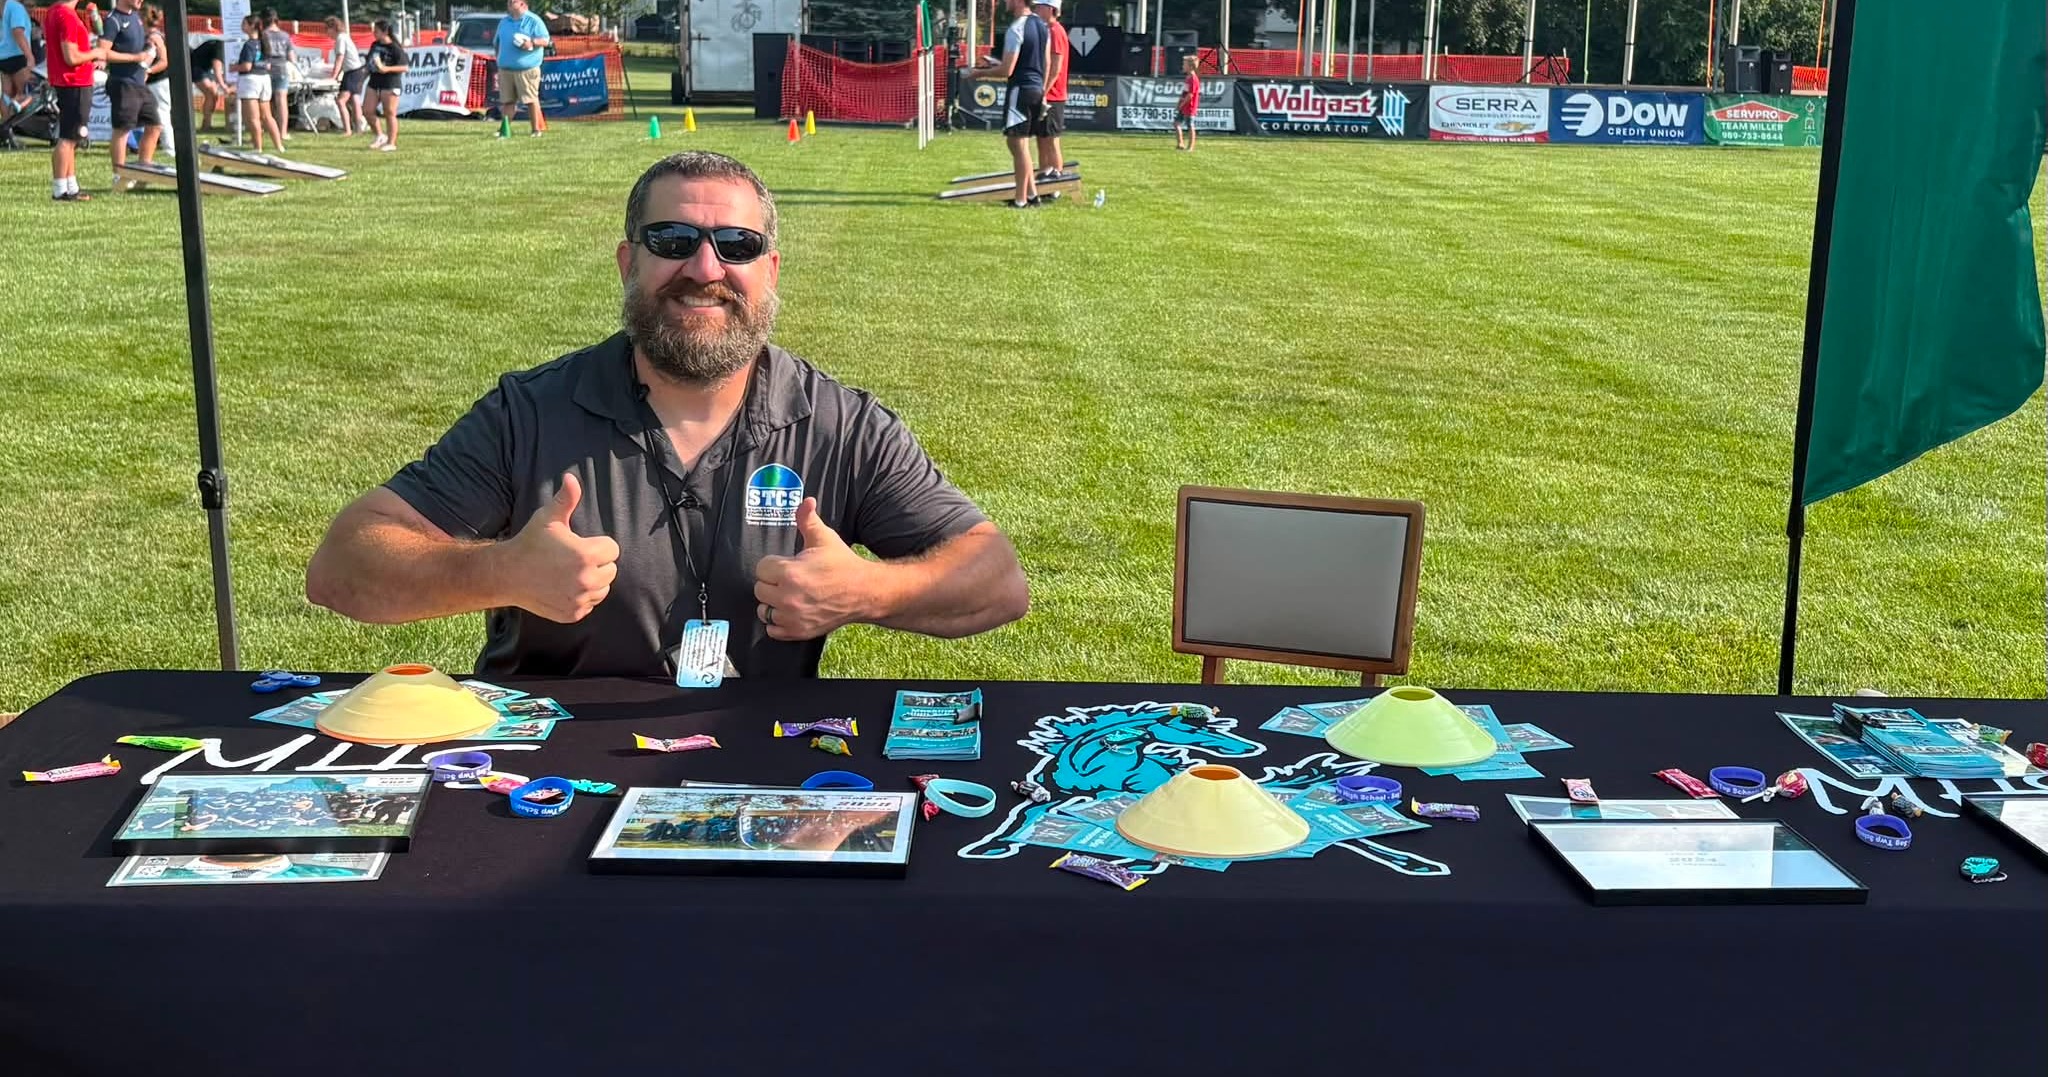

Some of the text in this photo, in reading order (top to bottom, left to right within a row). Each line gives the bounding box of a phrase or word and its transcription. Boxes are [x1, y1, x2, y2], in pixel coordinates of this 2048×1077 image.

[564, 67, 599, 81] VALLEY
[1253, 84, 1378, 122] Wolgast
[1456, 98, 1537, 112] SERRA
[1260, 122, 1369, 133] CORPORATION
[1720, 121, 1784, 131] TEAM MILLER
[1607, 128, 1685, 137] CREDIT UNION
[748, 489, 801, 507] STCS
[1876, 836, 1893, 847] Twp
